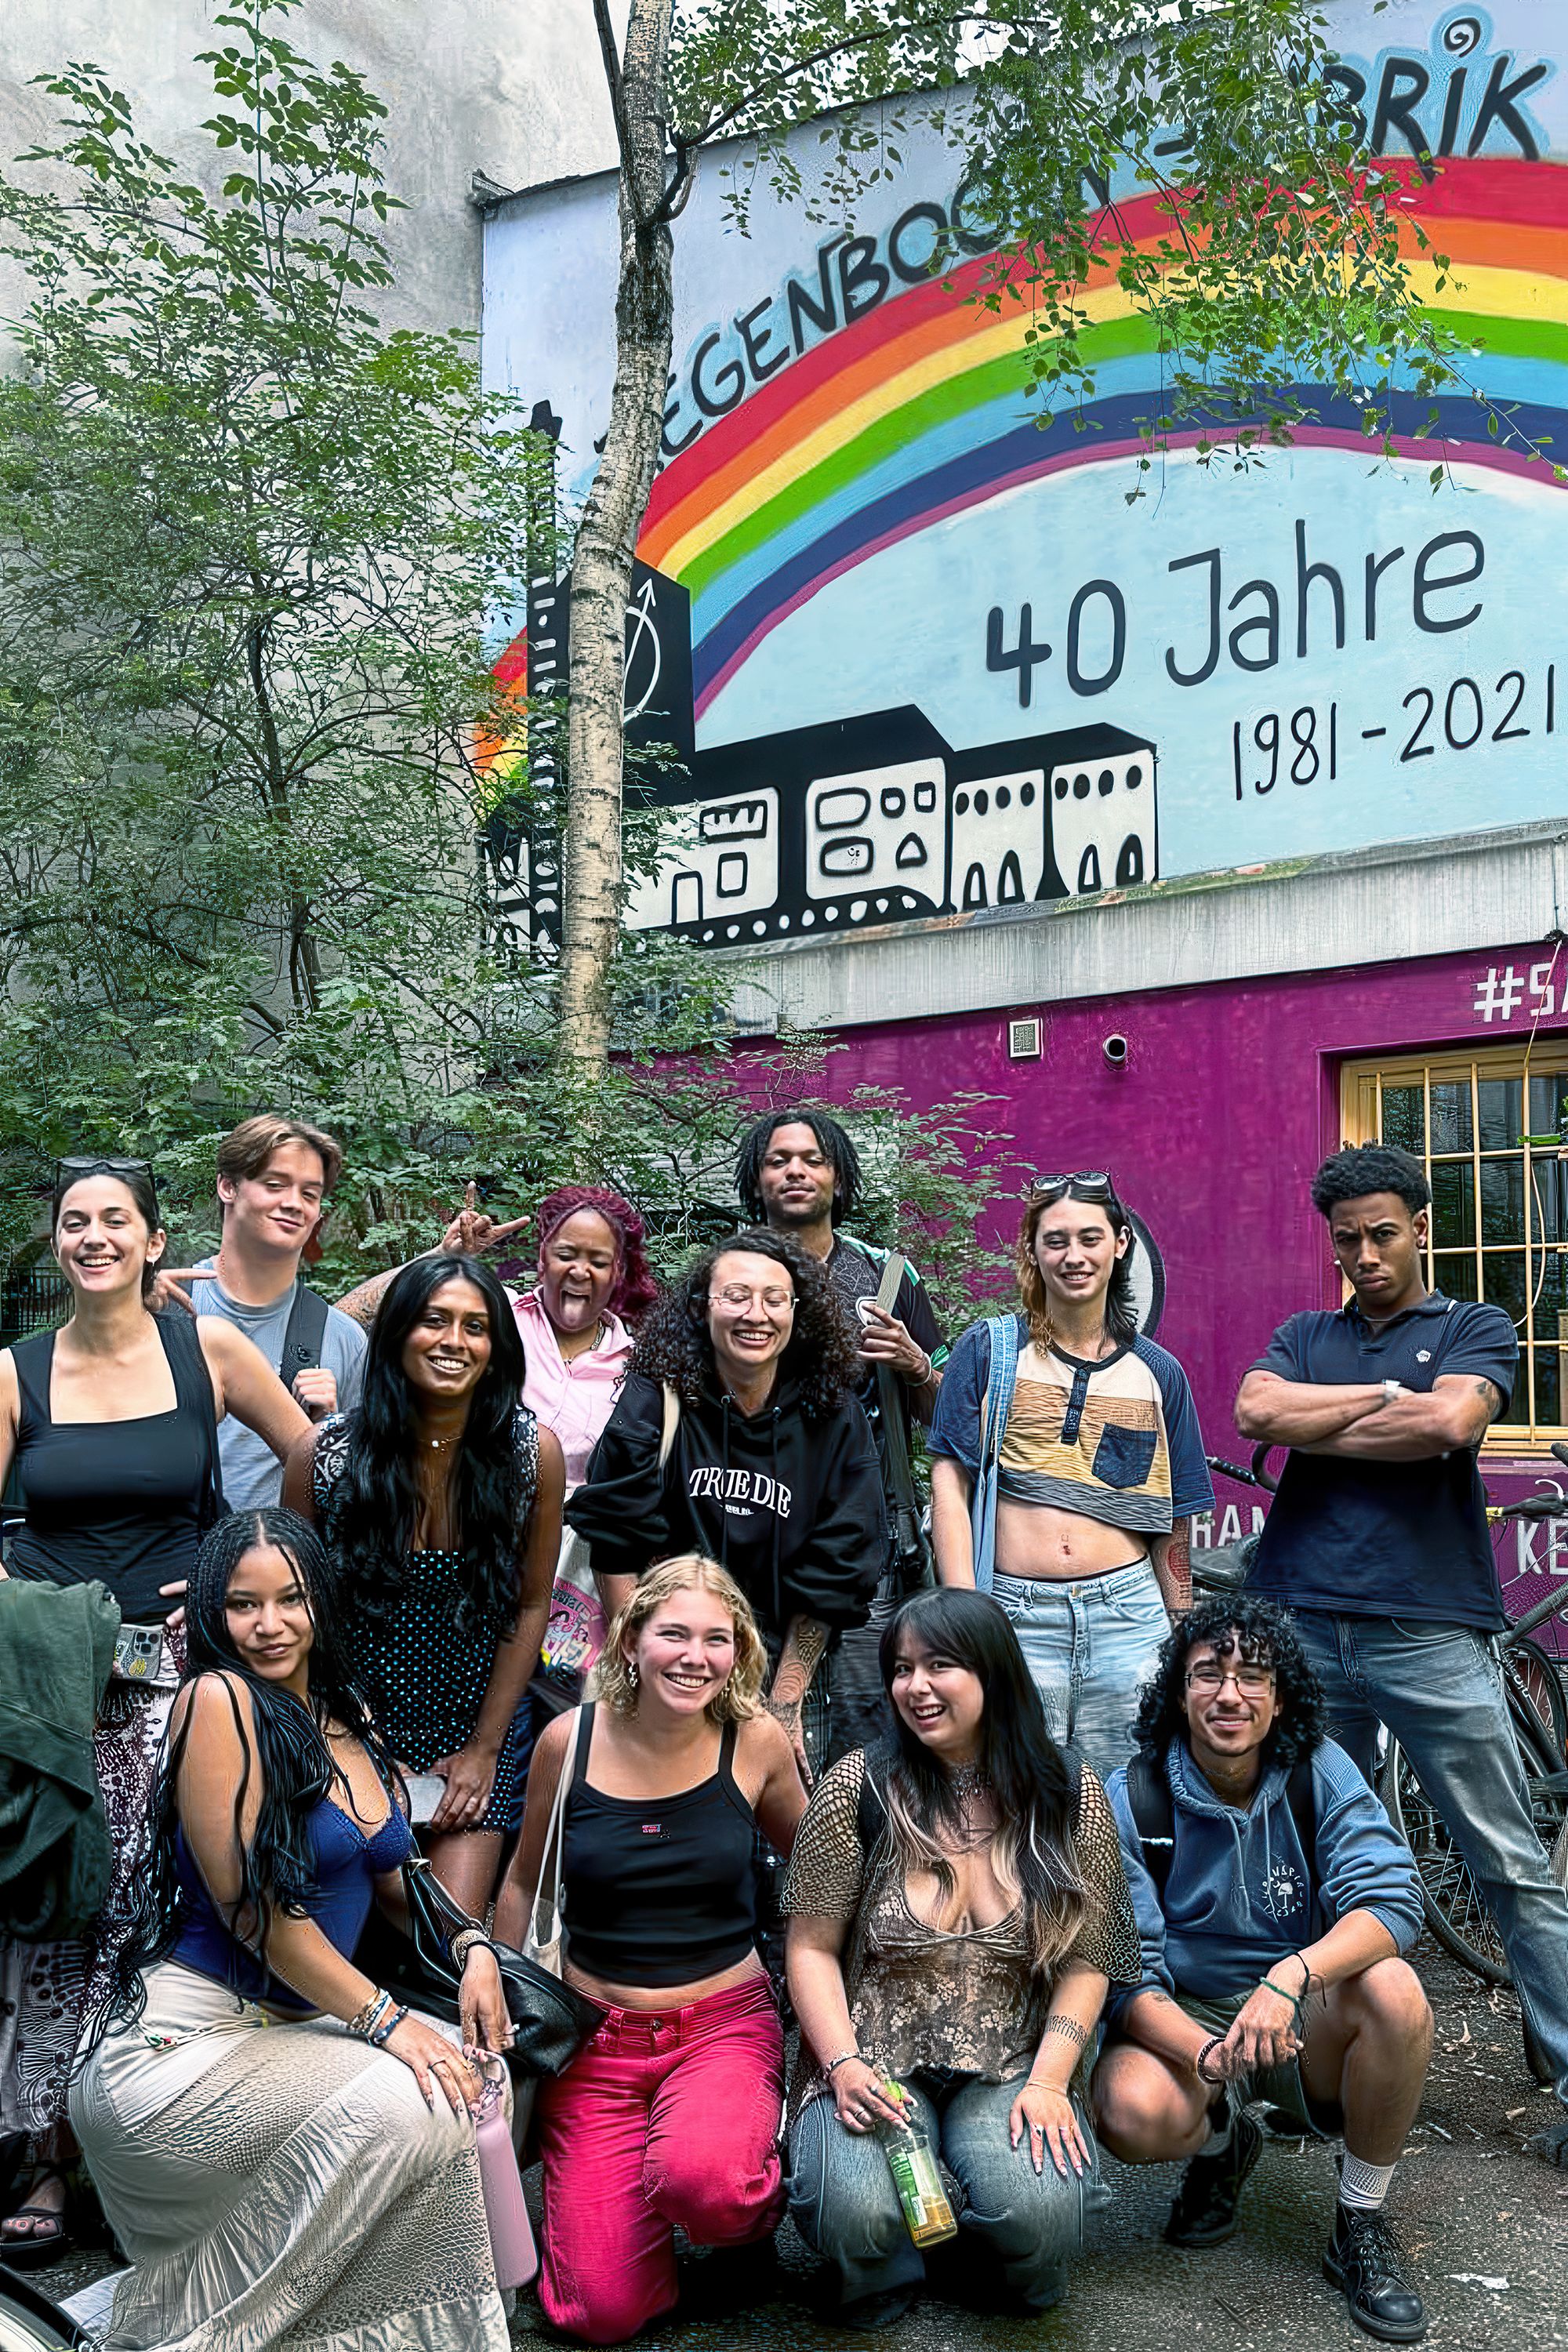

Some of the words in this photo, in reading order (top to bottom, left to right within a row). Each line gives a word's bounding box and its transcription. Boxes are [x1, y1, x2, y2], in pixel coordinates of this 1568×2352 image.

[986, 579, 1126, 708] 40
[1165, 519, 1485, 686] Jahre
[1474, 963, 1568, 1022] #S
